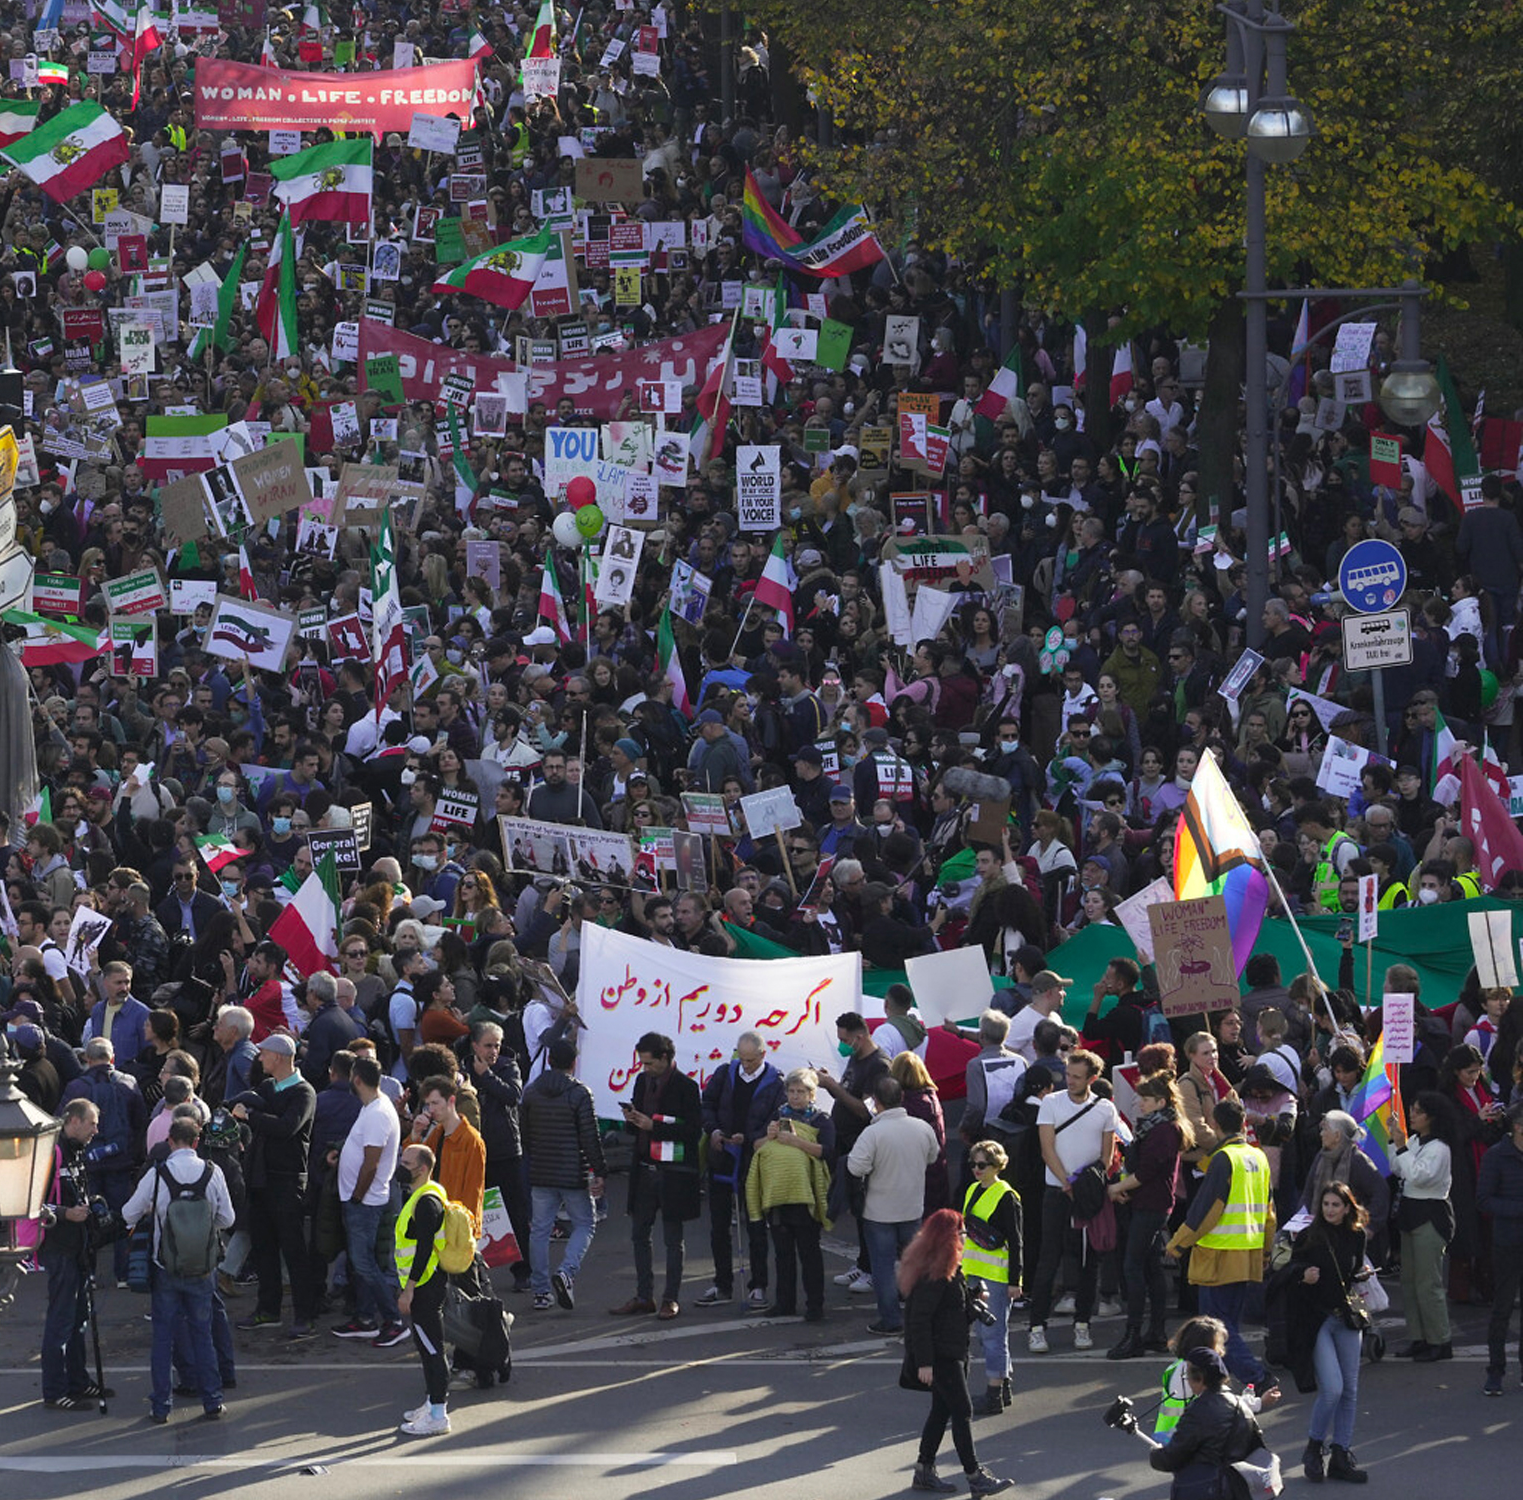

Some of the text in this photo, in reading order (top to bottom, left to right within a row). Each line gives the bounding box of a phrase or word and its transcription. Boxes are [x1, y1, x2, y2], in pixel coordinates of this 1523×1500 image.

[201, 87, 282, 101] WOMAN
[302, 89, 360, 104] LIFE
[462, 155, 476, 163] LIFE
[567, 338, 584, 349] LIFE
[368, 366, 394, 377] IRAN
[909, 402, 932, 412] LIFE
[549, 431, 597, 462] YOU
[1375, 439, 1394, 447] ONLY
[252, 463, 291, 489] WOMEN
[740, 476, 774, 487] WORLD
[740, 498, 774, 509] I'M YOUR
[741, 509, 774, 521] VOICE!
[909, 541, 949, 555] WOMEN
[911, 554, 937, 567] LIFE
[46, 577, 64, 586] FRAU
[40, 599, 67, 608] FREIHEIT
[220, 624, 242, 634] LEBEN
[303, 629, 320, 639] LIFE
[442, 788, 478, 803] WOMEN
[443, 804, 468, 819] LIFE
[1153, 915, 1226, 937] LIFE FREEDOM
